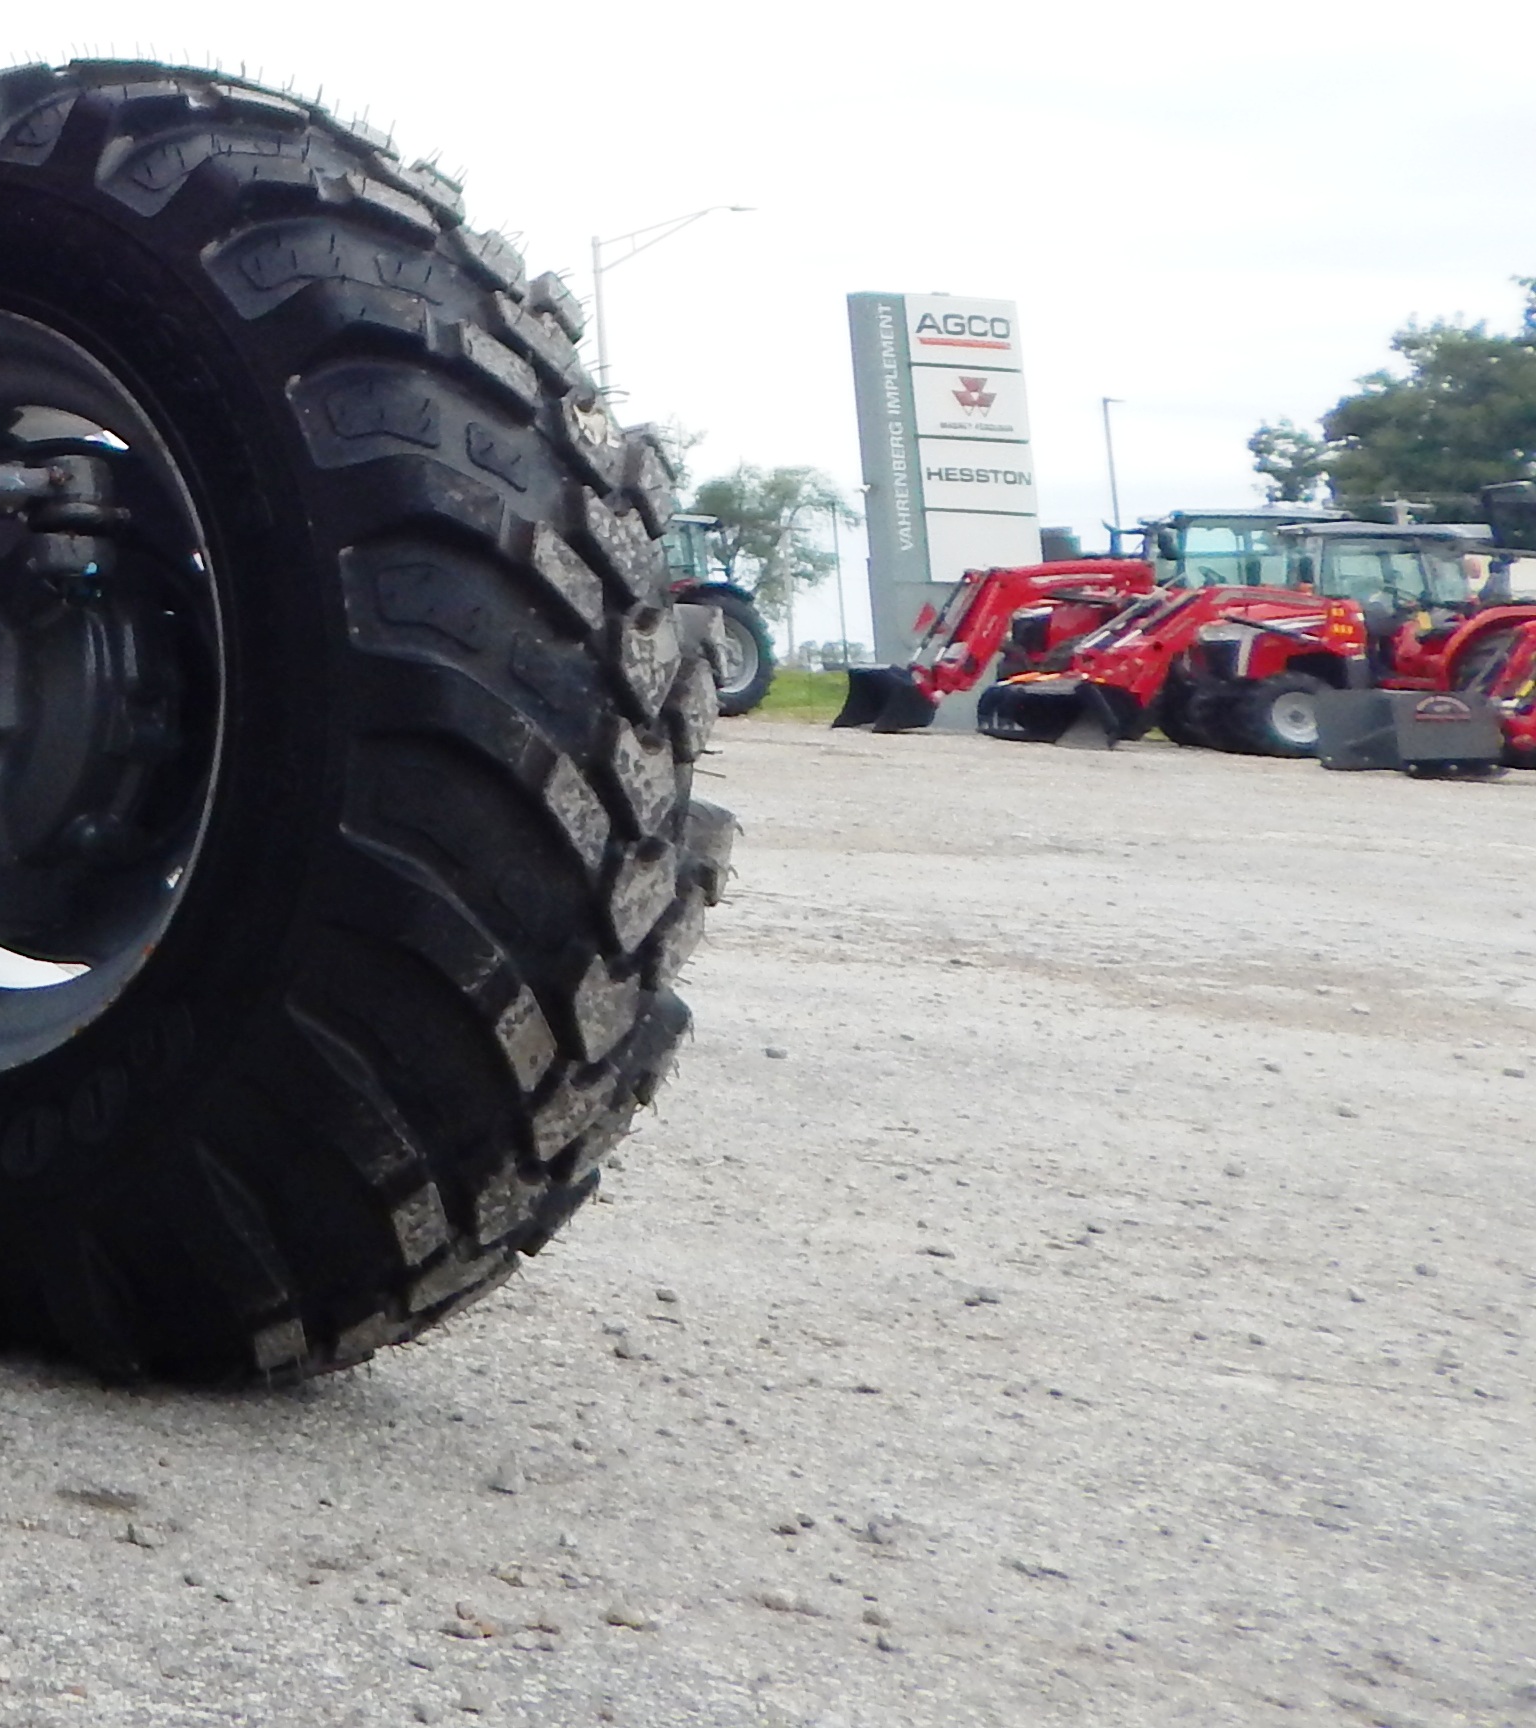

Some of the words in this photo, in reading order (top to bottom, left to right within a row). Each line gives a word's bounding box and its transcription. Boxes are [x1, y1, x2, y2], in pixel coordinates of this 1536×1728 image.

[878, 303, 902, 415] IMPLEMENT
[916, 313, 1010, 339] AGCO
[889, 421, 914, 551] VAHRENBERG
[926, 467, 1032, 486] HESSTON
